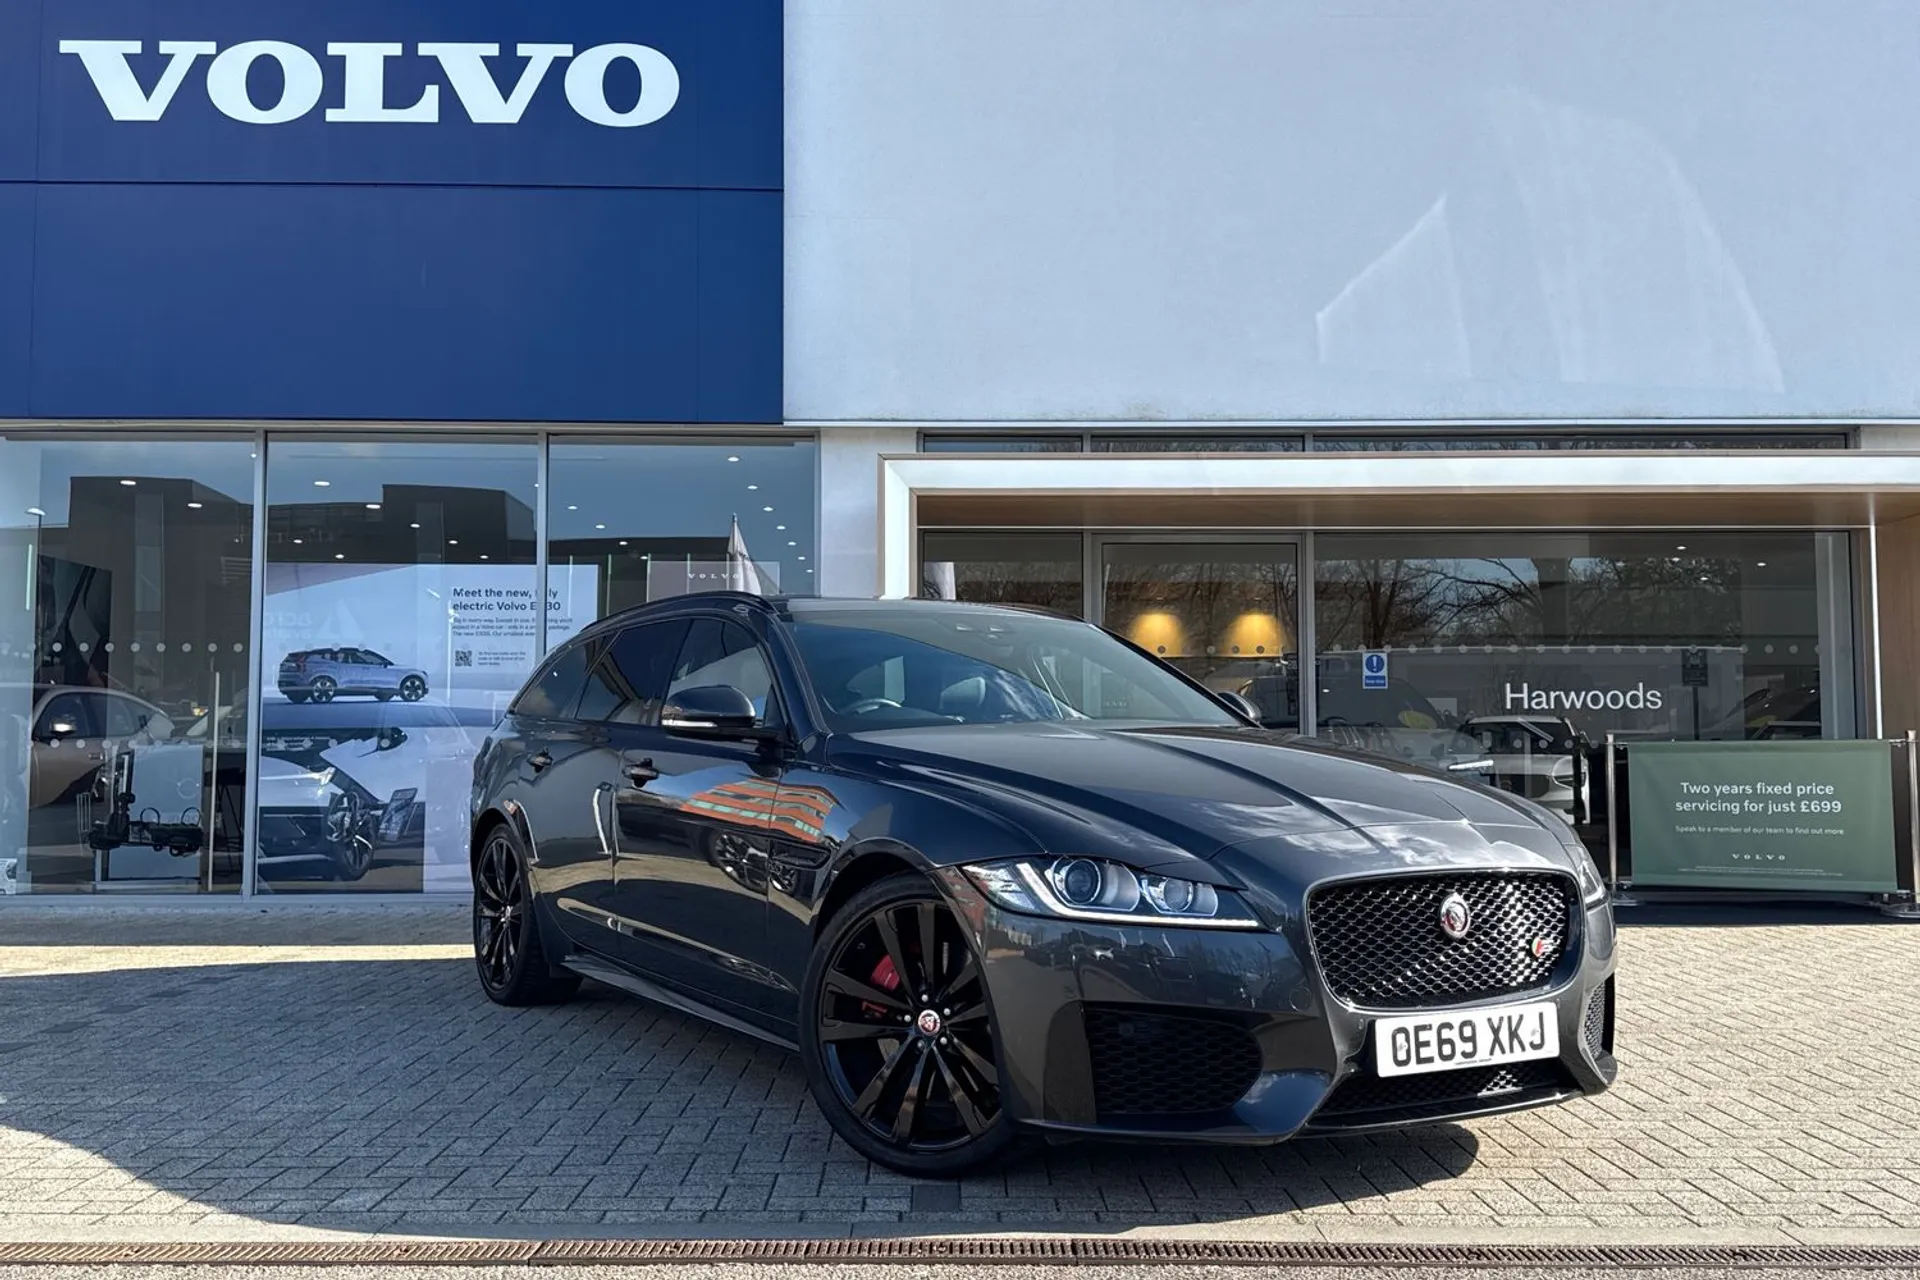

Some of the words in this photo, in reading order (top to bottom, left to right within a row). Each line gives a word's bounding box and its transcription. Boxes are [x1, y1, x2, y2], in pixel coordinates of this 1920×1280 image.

[59, 40, 680, 127] VOLVO
[453, 588, 482, 597] Meet
[485, 588, 503, 597] the
[506, 589, 532, 599] new,
[453, 602, 494, 610] electric
[497, 602, 527, 610] Volvo
[530, 602, 561, 610] E30
[1505, 682, 1662, 710] Harwoods
[1680, 782, 1710, 794] Two
[1714, 785, 1753, 797] years
[1756, 782, 1792, 795] fixed
[1796, 782, 1834, 798] price
[1675, 800, 1740, 814] servicing
[1744, 800, 1764, 812] for
[1768, 800, 1796, 816] just
[1800, 800, 1842, 813] £699
[1731, 853, 1786, 861] VOLVO
[1391, 1020, 1478, 1067] OE69
[1487, 1012, 1545, 1056] XKJ
